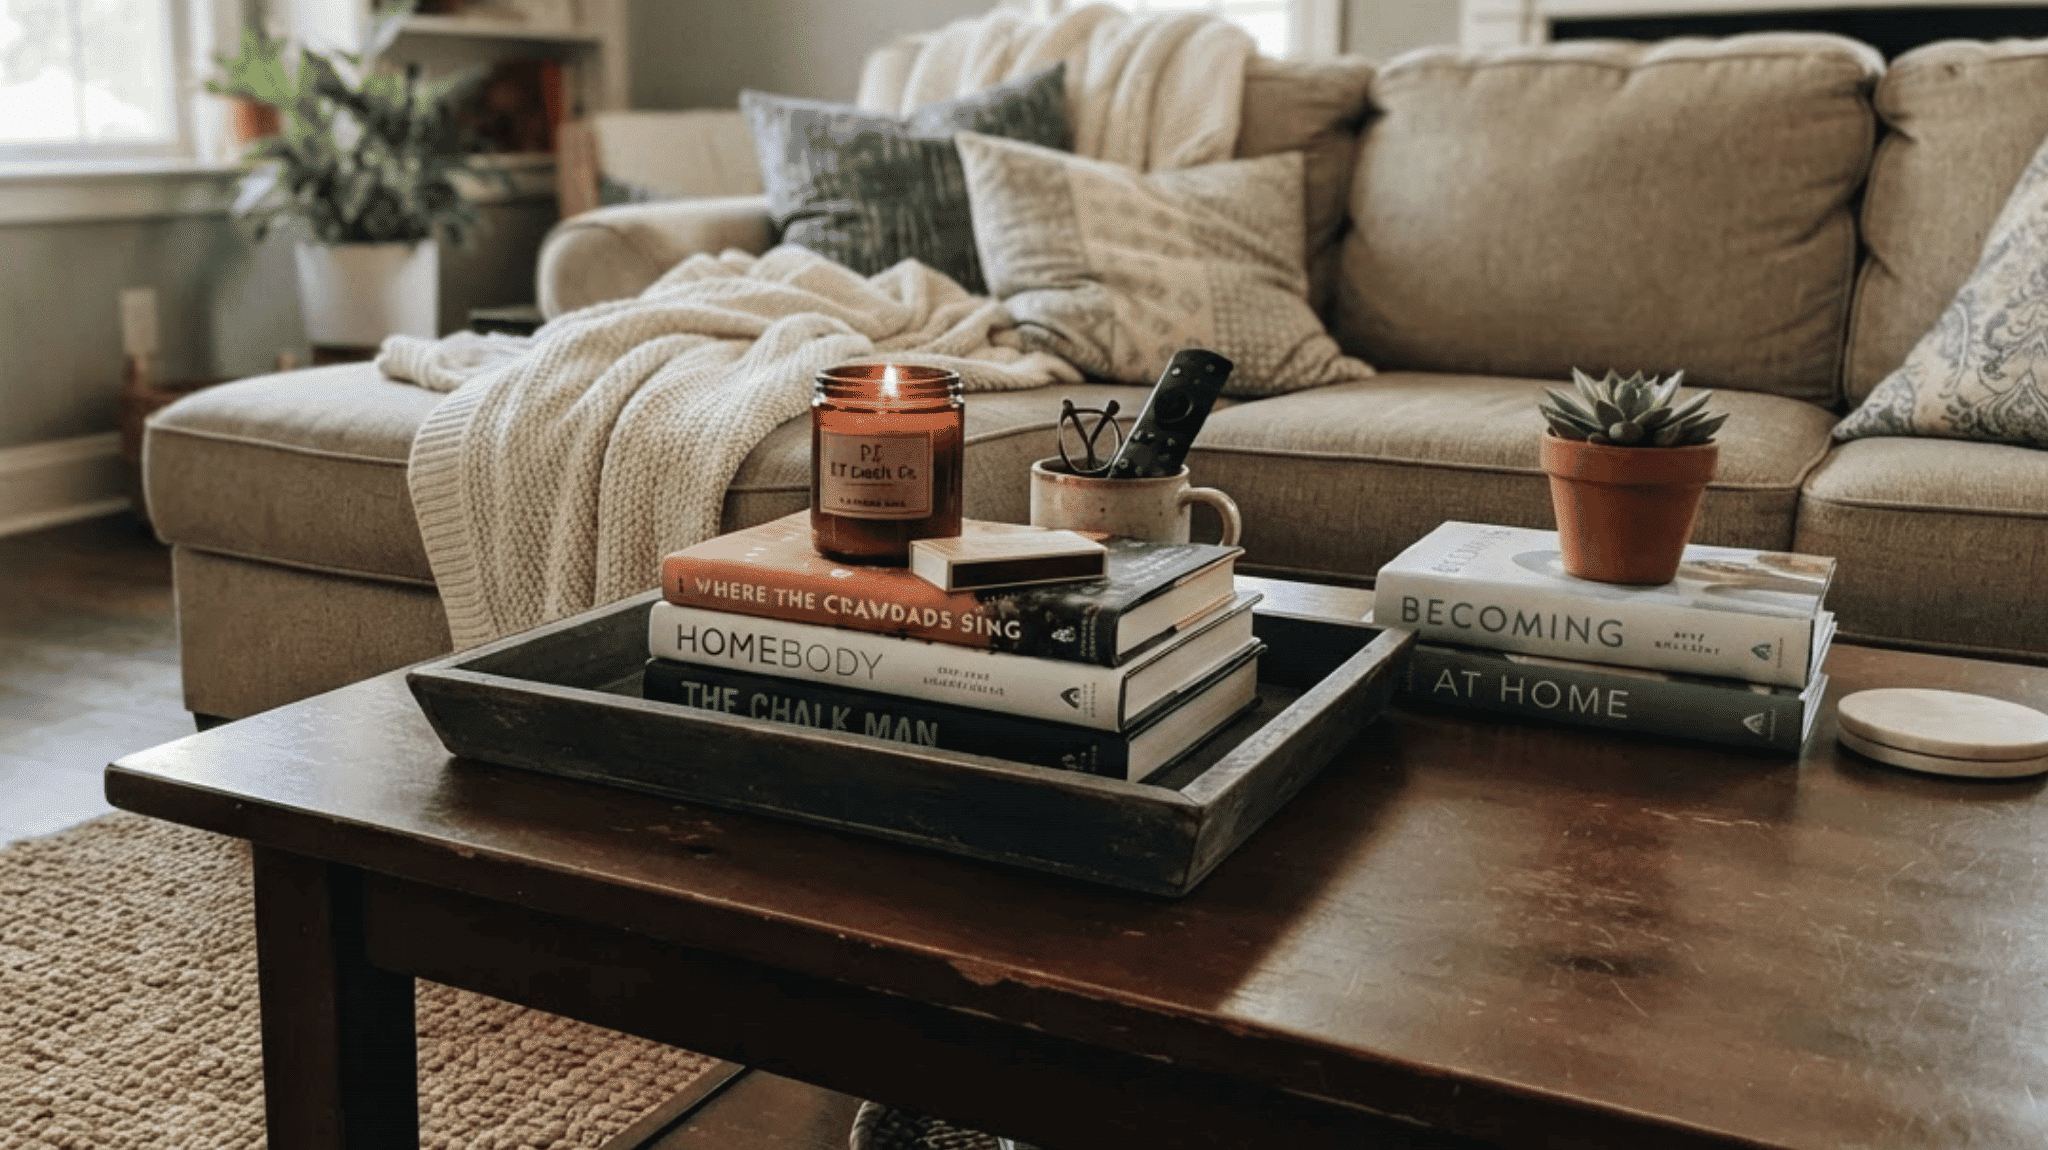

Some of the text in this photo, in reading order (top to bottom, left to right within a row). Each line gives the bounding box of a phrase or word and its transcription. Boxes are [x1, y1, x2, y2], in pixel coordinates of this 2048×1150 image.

[695, 576, 1022, 640] WHERE THE CRAWDADS SING
[1401, 596, 1624, 648] BECOMING
[677, 624, 884, 681] HOMEBODY
[681, 680, 939, 748] THE CHALK MAN
[1433, 669, 1482, 698] AT
[1501, 675, 1630, 719] HOME
